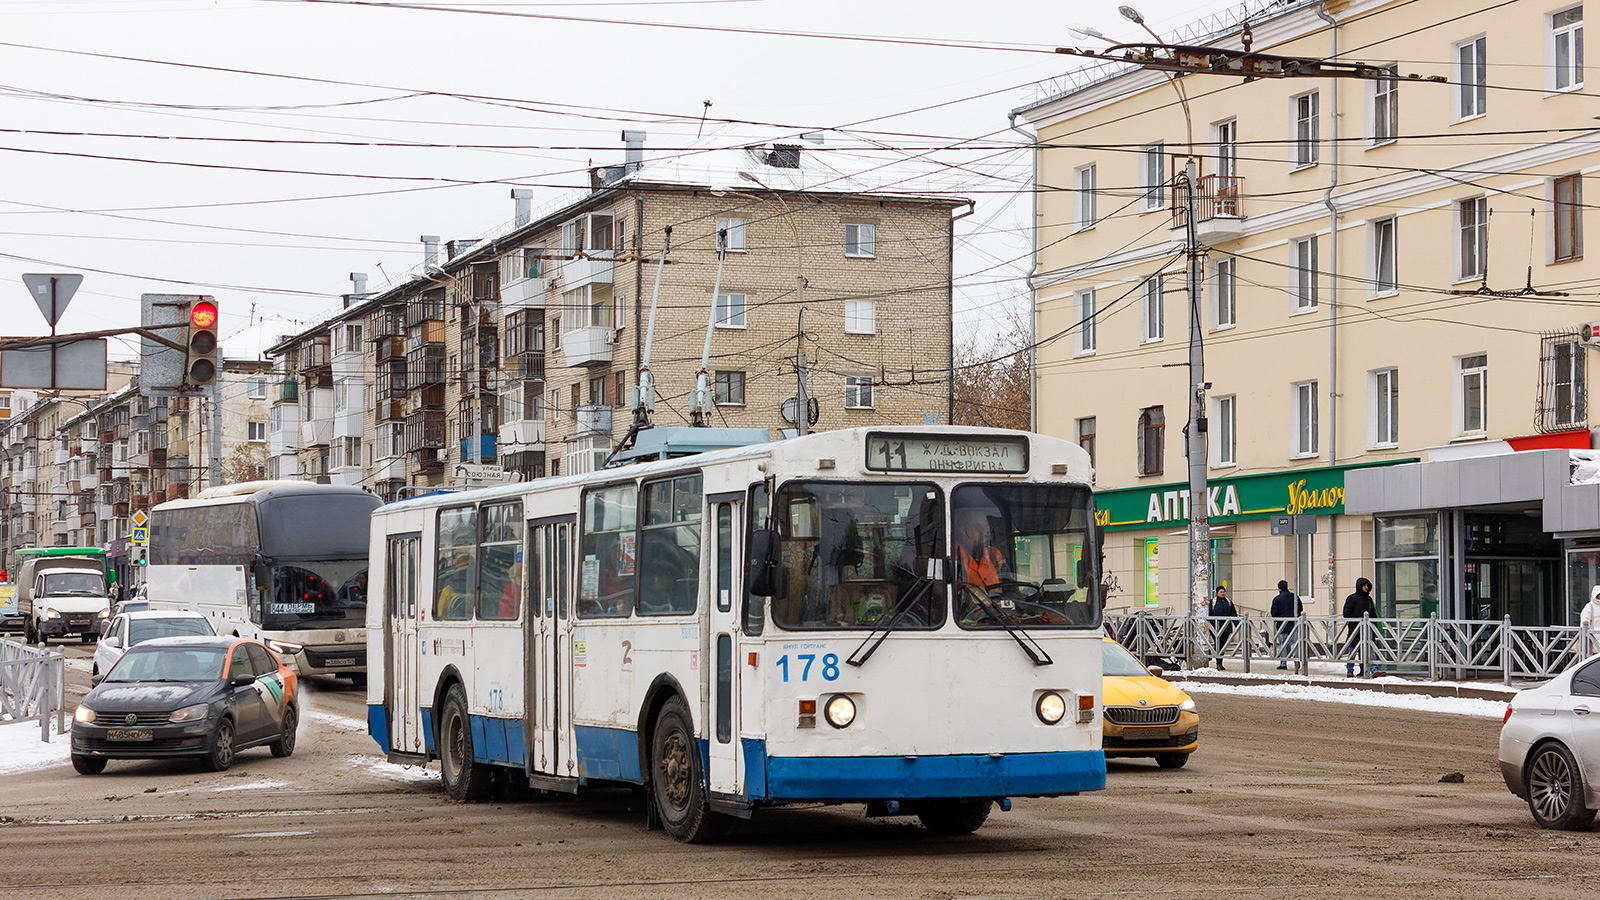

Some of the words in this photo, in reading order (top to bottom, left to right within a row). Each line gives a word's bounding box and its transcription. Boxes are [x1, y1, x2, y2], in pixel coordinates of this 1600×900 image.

[879, 440, 907, 469] 11
[959, 444, 1009, 458] ВОКЗАЛ
[466, 471, 501, 479] СОЮЗНАЯ
[1147, 484, 1241, 523] АПТКА
[776, 652, 840, 682] 178
[488, 689, 504, 711] 178
